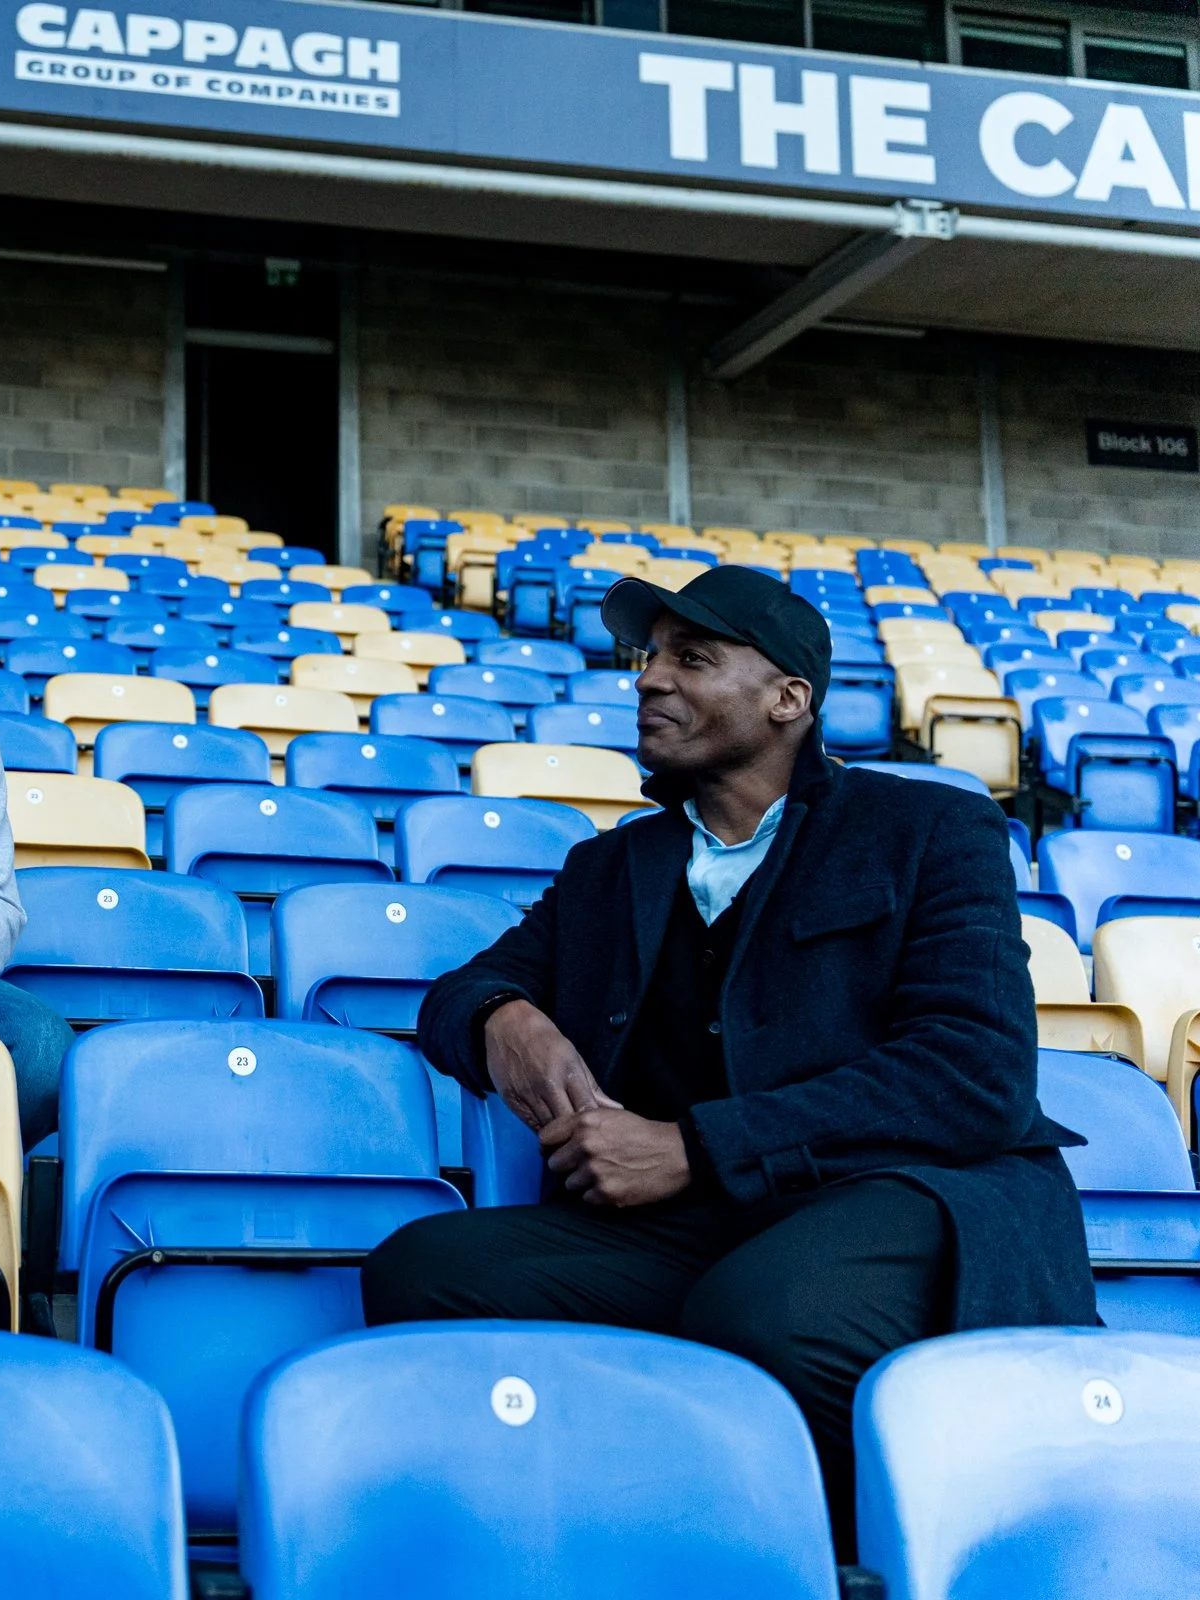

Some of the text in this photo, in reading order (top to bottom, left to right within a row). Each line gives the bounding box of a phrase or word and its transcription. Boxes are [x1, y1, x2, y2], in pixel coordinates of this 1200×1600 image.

[16, 3, 400, 83] CAPPAGH
[27, 60, 391, 110] GROUP OF COMPANIES
[639, 52, 1200, 212] THE CA
[1097, 431, 1152, 453] Block
[103, 895, 113, 903] 23
[391, 909, 401, 917] 24
[236, 1056, 249, 1066] 23
